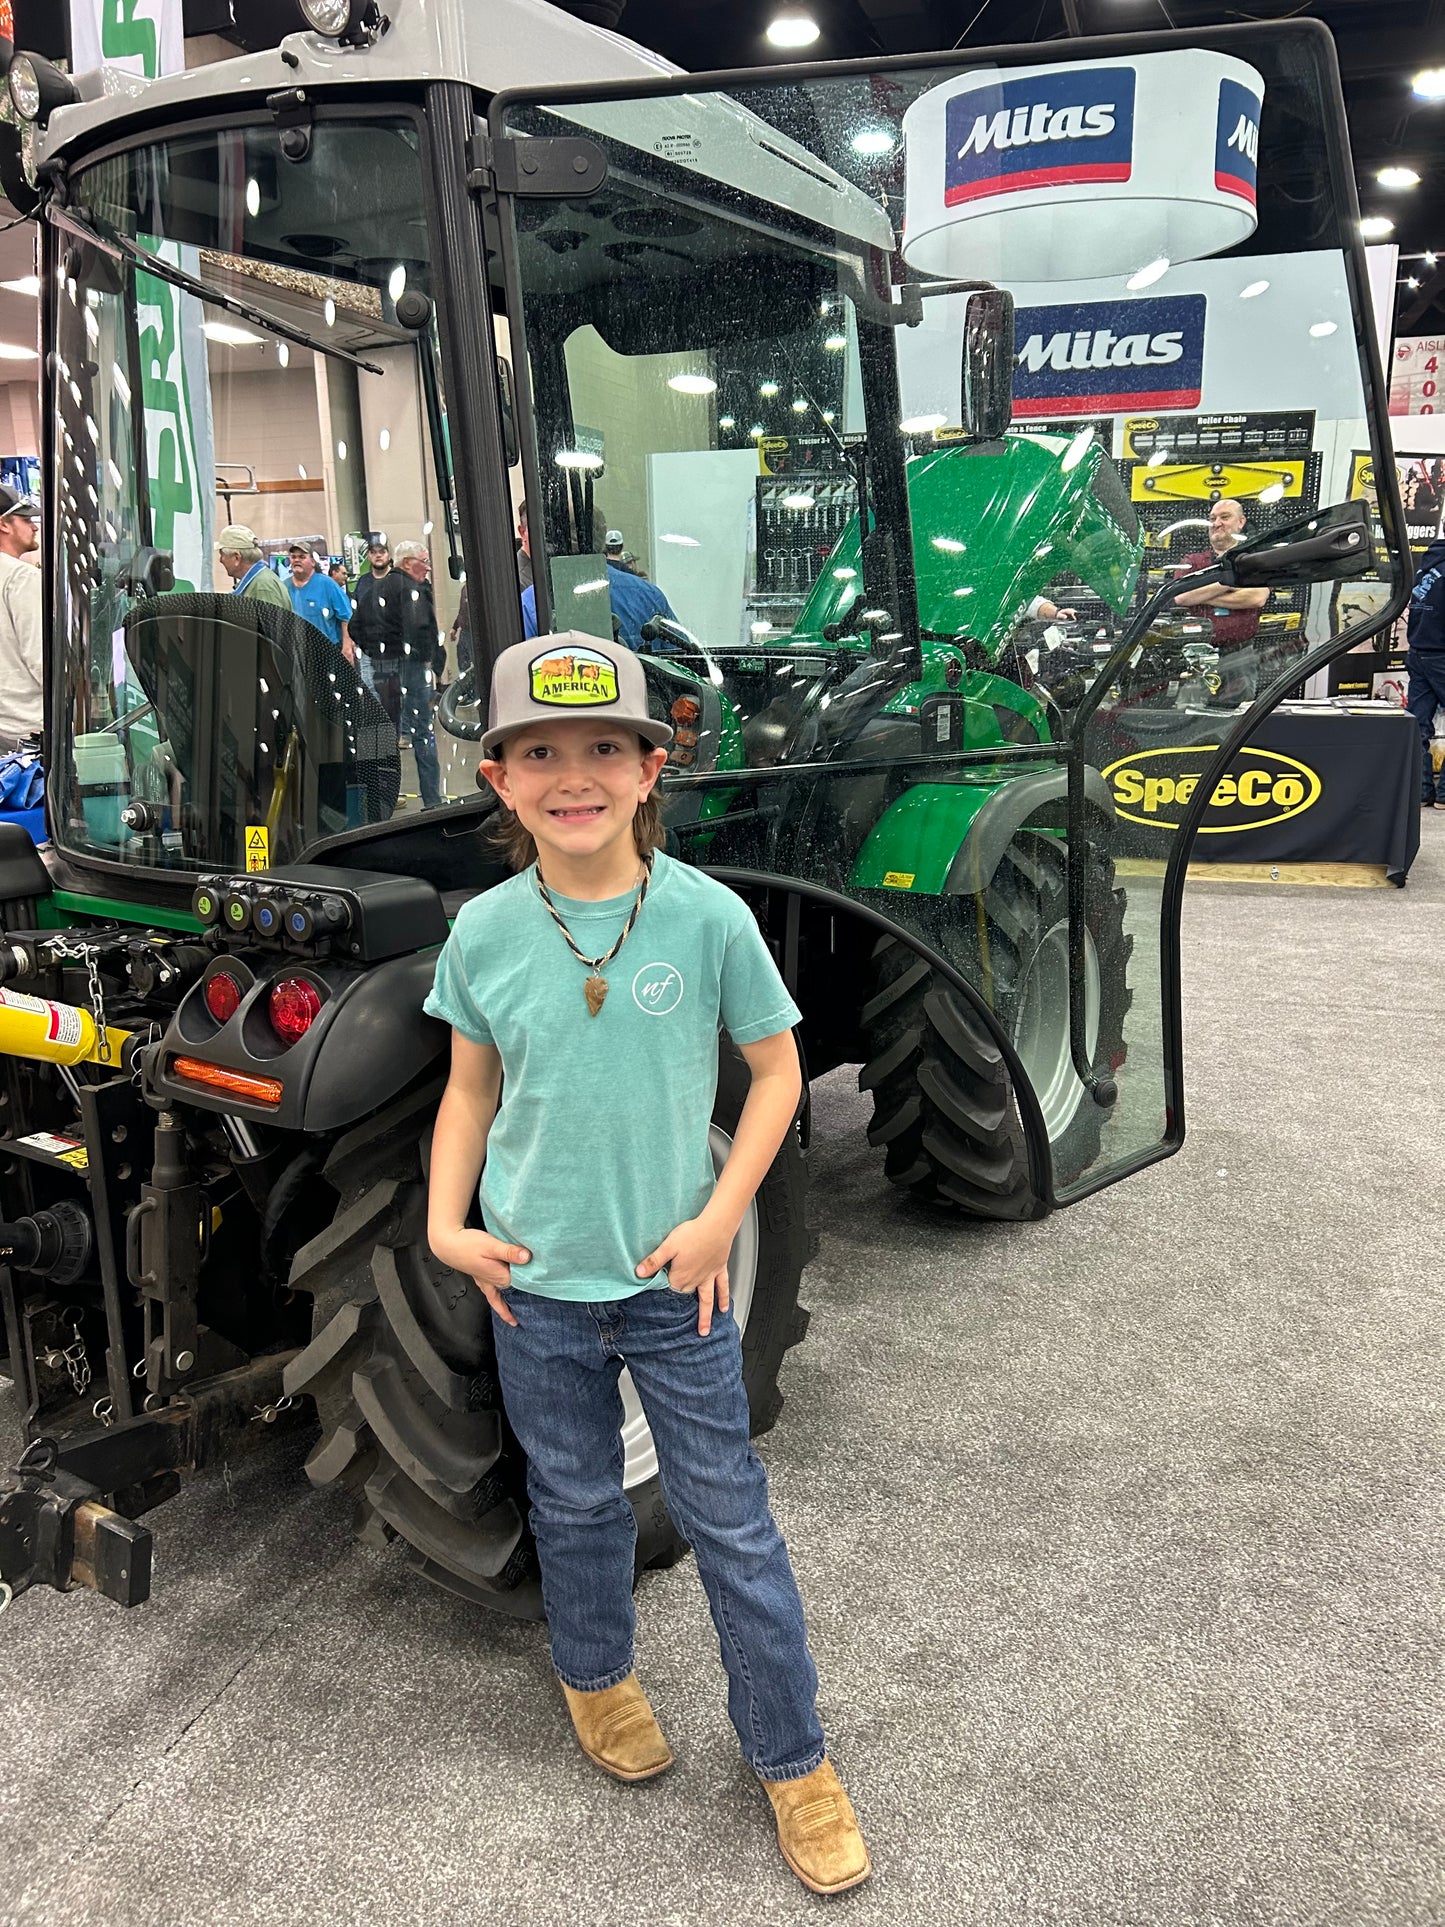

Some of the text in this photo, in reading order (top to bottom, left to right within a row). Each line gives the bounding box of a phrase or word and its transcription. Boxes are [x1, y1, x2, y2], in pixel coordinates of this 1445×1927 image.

[958, 103, 1115, 158] Mitas
[1018, 329, 1184, 373] Mitas
[1416, 340, 1445, 352] AISL
[1128, 422, 1157, 432] SpeeCo
[1197, 415, 1247, 425] Roller Chain
[1025, 425, 1047, 433] Fence
[1205, 478, 1228, 487] SpeeCo
[542, 682, 608, 698] AMERICAN
[1113, 769, 1305, 812] SpeeCo
[641, 973, 675, 1005] nf
